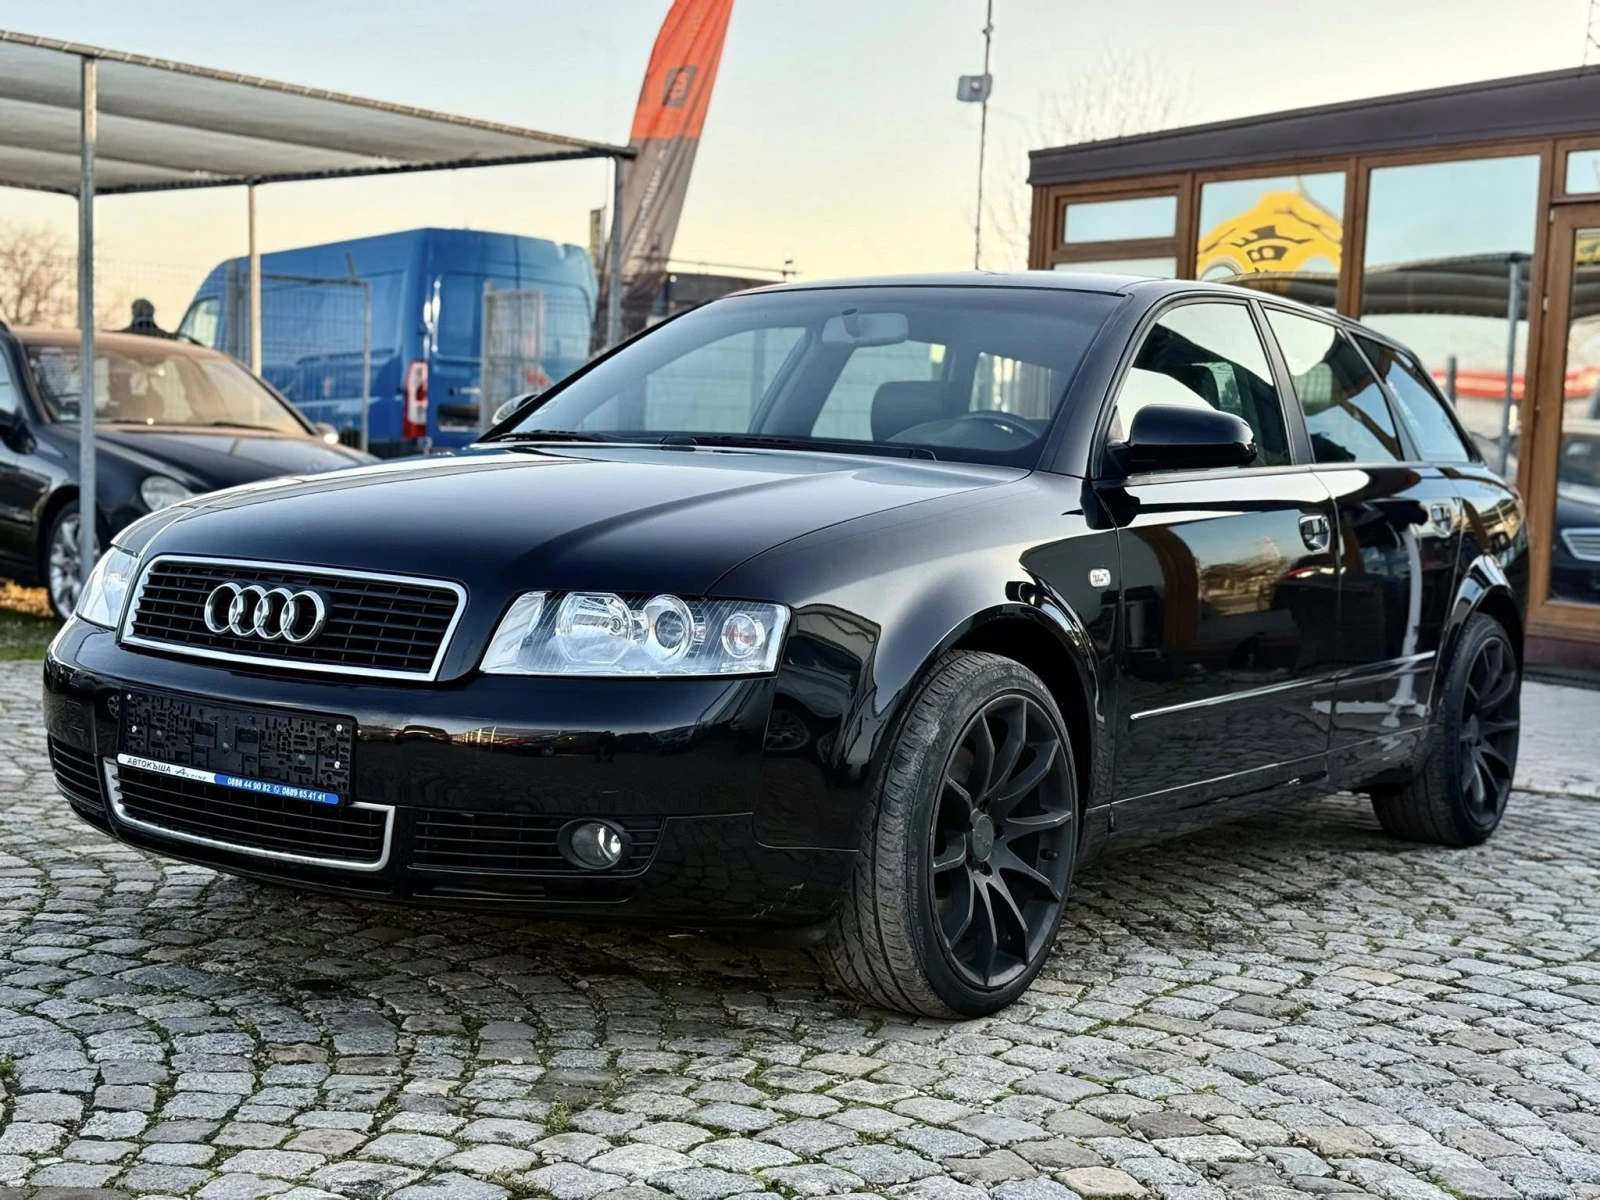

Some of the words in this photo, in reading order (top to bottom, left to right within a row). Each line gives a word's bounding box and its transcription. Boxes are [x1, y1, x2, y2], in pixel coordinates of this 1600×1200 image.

[244, 781, 252, 789] 44
[262, 784, 271, 793] 82
[308, 791, 317, 800] 41
[318, 793, 326, 802] 41
